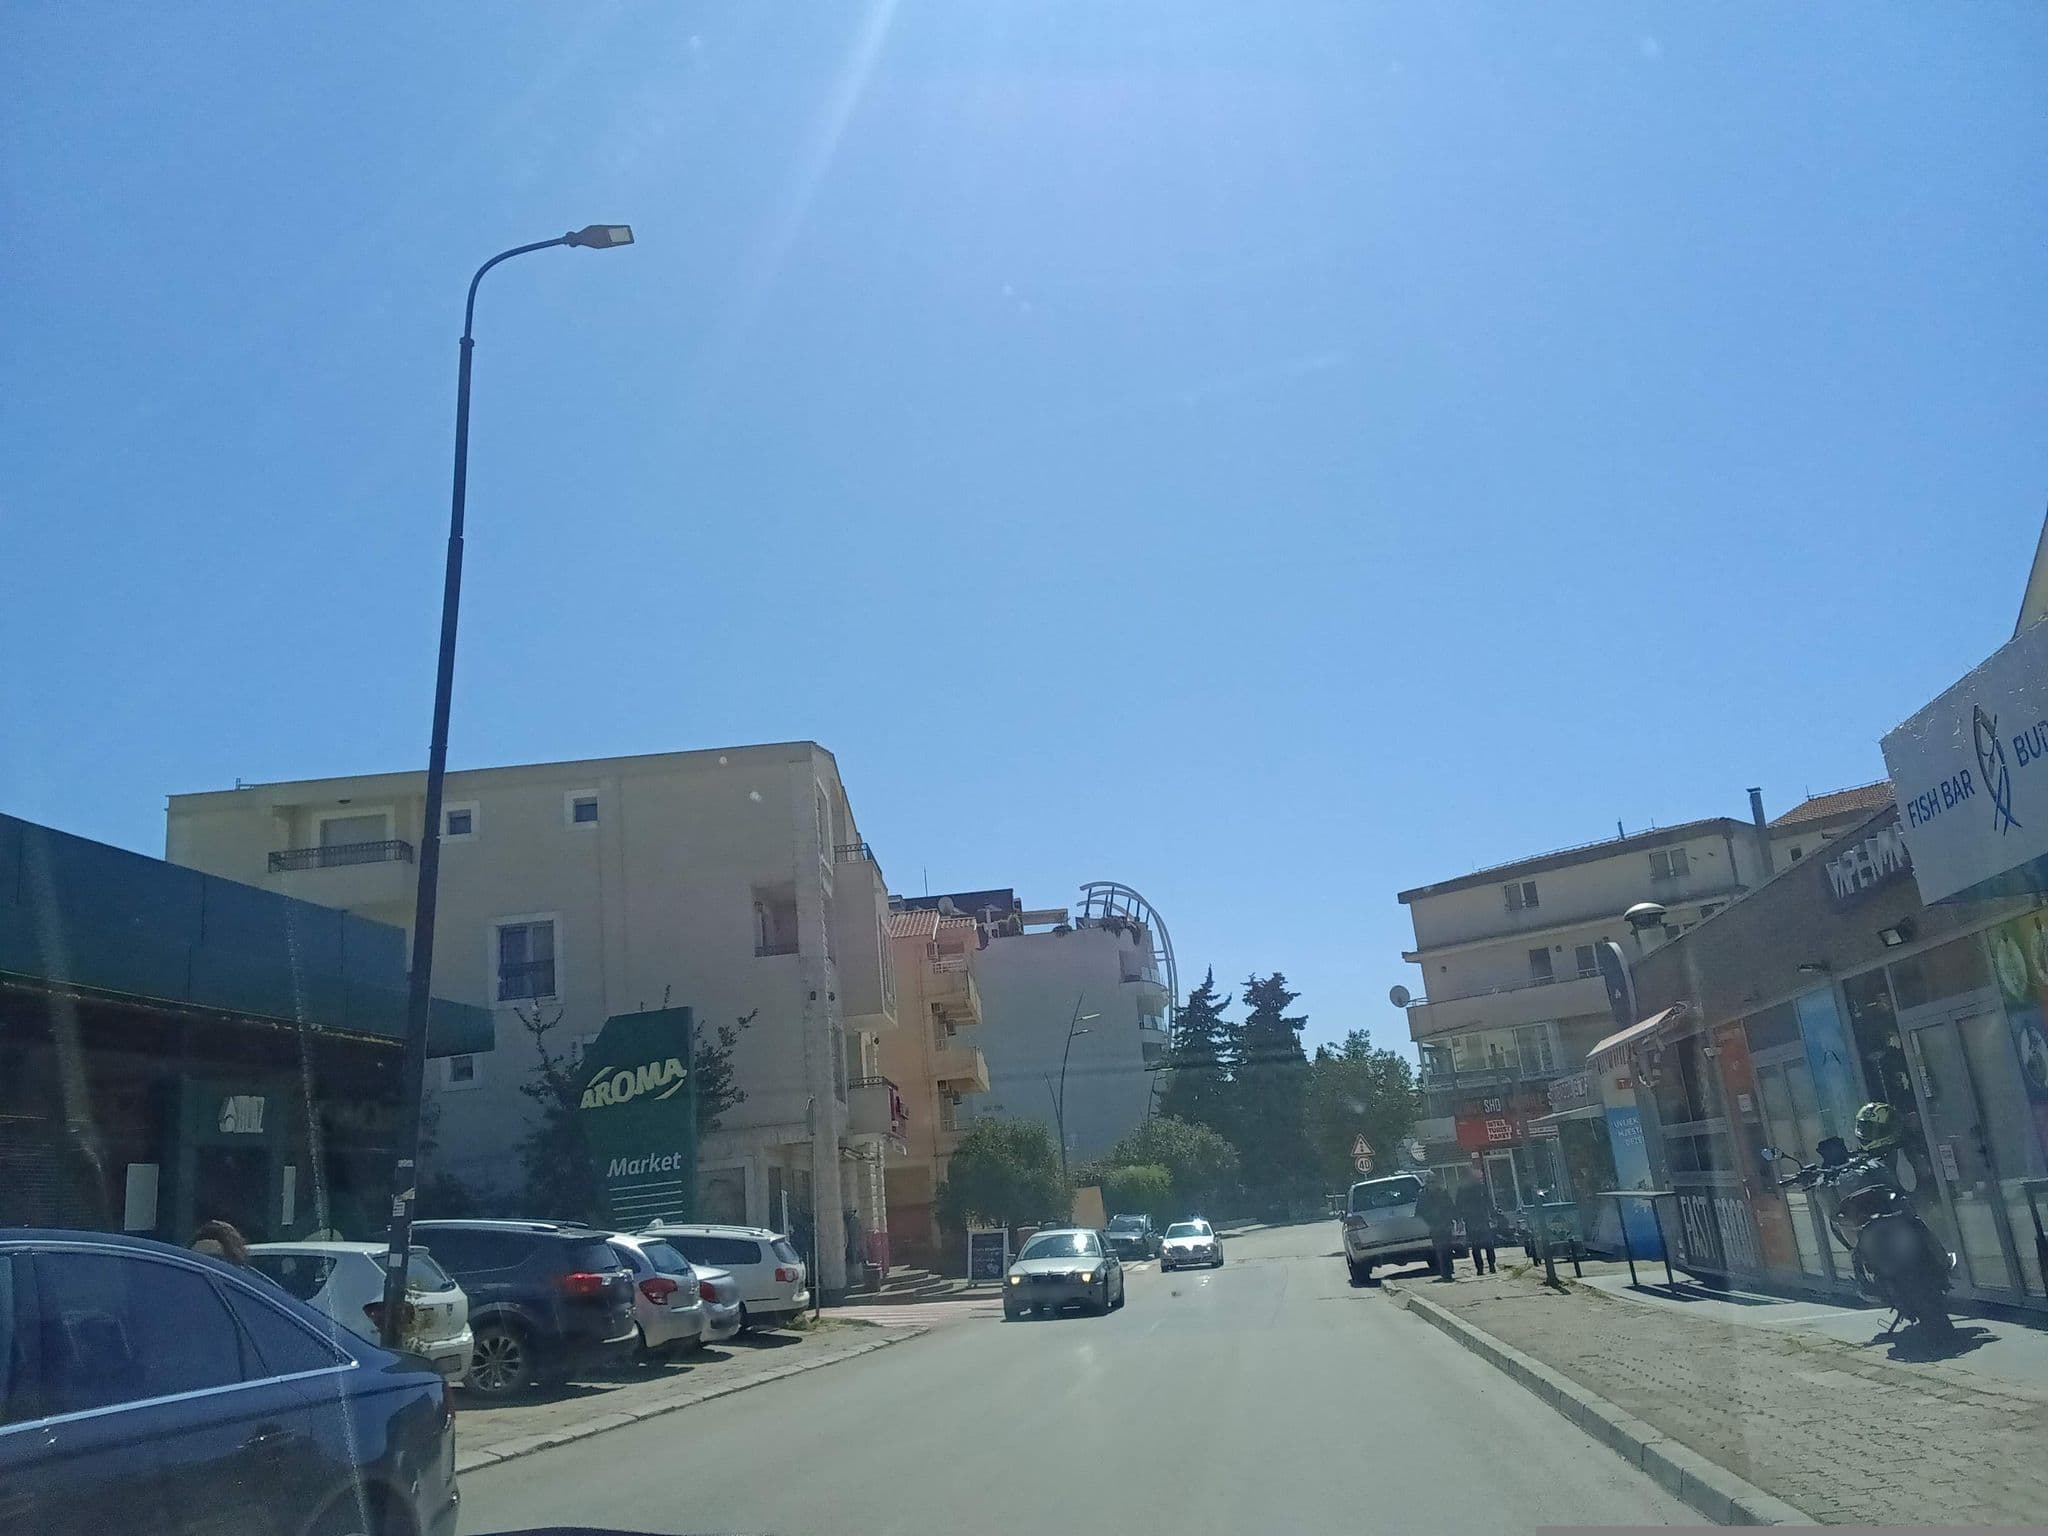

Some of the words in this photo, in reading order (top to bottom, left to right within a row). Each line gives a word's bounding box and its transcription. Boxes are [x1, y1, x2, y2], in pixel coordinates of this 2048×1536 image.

[1907, 788, 1943, 828] FISH
[1941, 768, 1976, 810] BAR
[579, 1057, 687, 1109] AROMA
[606, 1151, 682, 1178] Market
[1680, 1195, 1716, 1258] FAST
